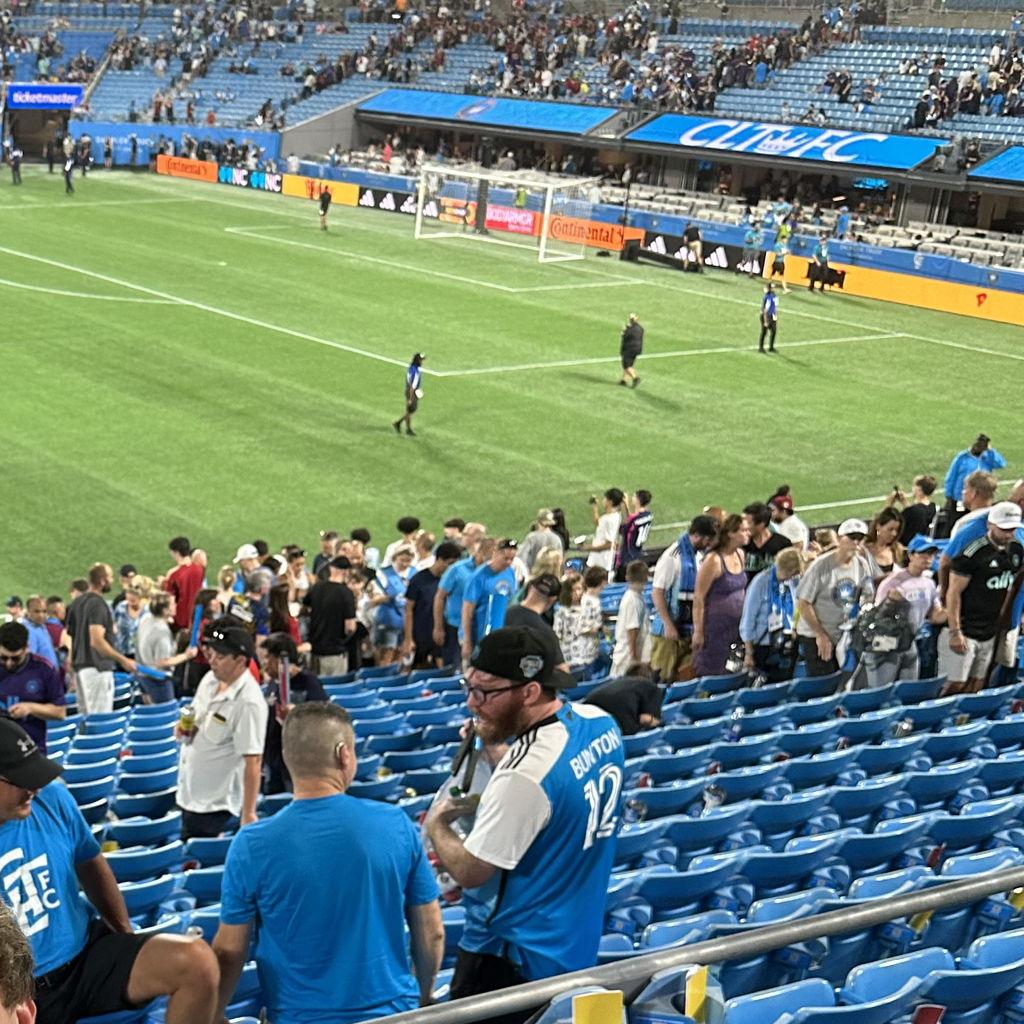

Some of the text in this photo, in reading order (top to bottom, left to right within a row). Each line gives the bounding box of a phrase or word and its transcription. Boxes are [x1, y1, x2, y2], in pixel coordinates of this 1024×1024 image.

[13, 91, 78, 104] ticketmaster
[551, 216, 615, 243] Continental
[582, 762, 624, 851] 12
